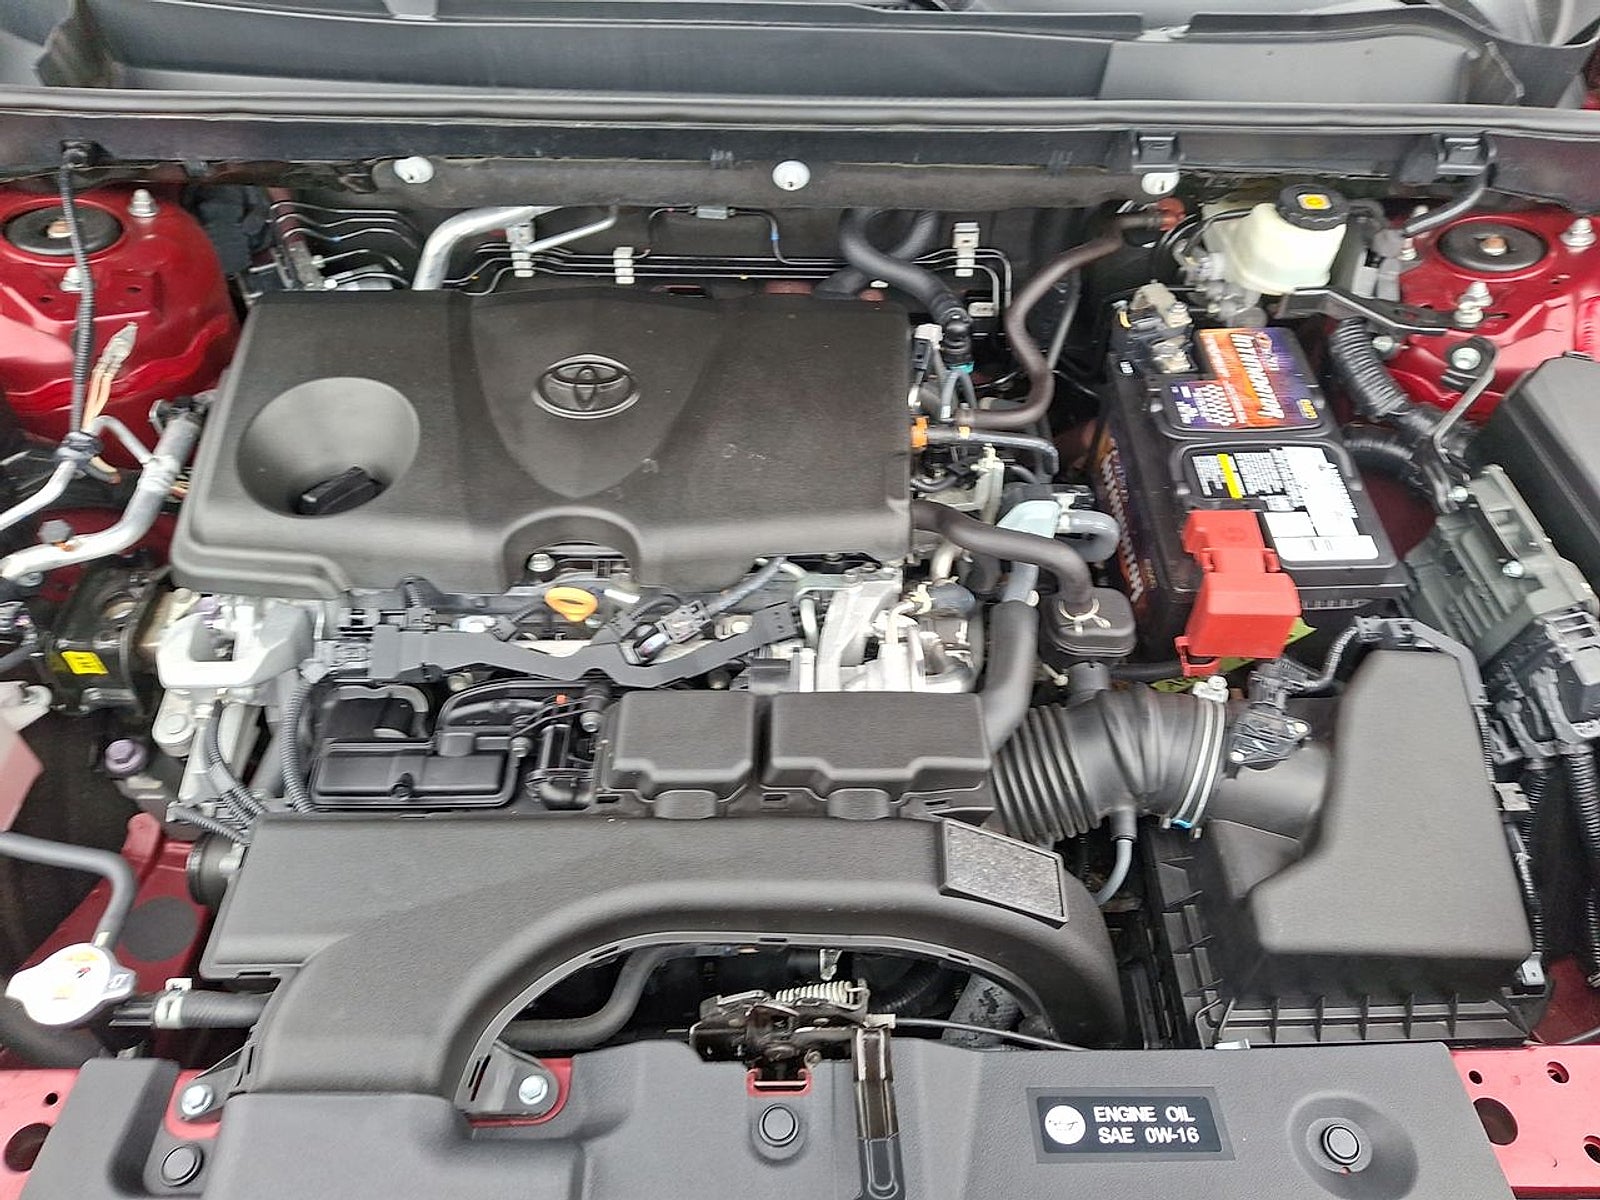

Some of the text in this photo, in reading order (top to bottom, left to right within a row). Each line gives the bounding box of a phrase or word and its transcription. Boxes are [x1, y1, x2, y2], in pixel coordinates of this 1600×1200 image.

[1093, 1106, 1196, 1123] ENGINE OIL
[1098, 1126, 1200, 1144] SAE 0W-16
